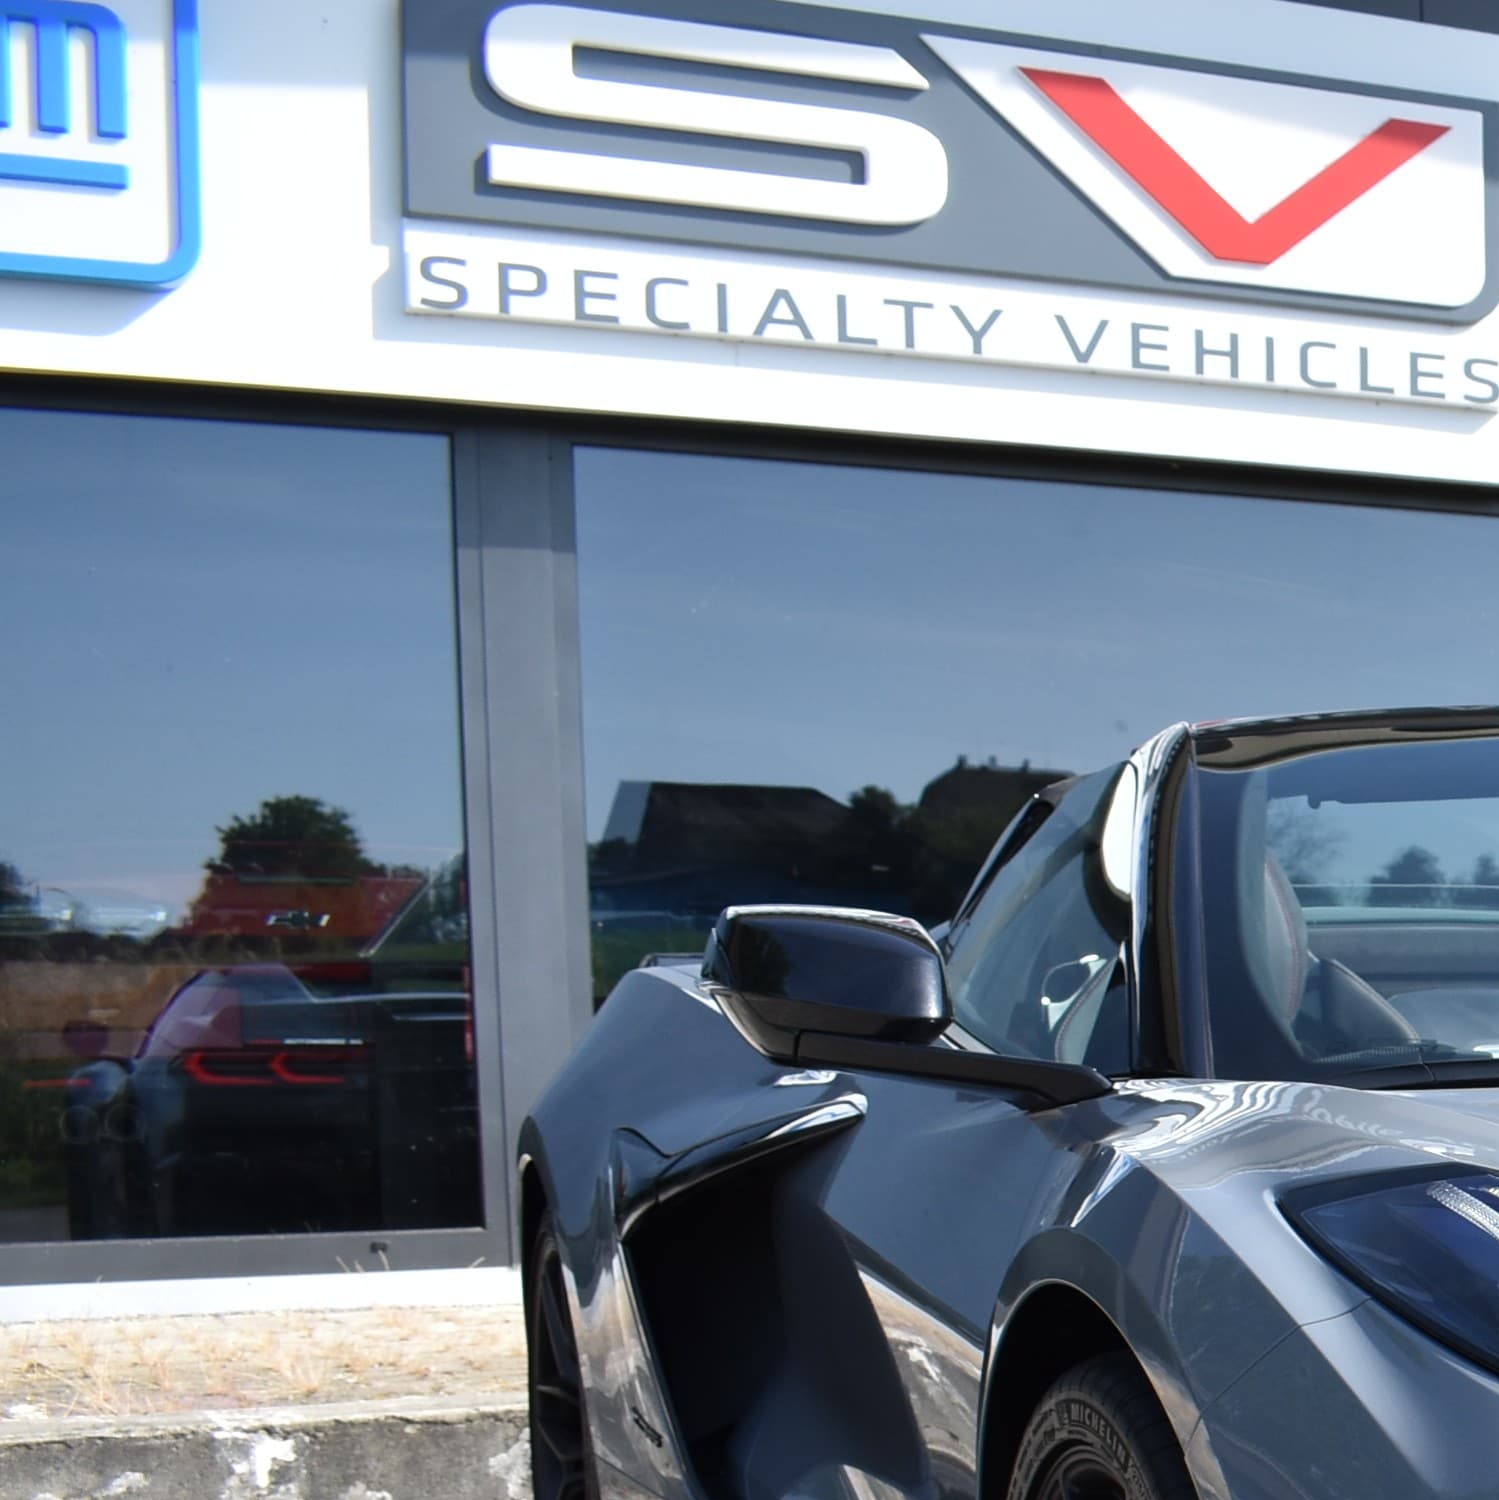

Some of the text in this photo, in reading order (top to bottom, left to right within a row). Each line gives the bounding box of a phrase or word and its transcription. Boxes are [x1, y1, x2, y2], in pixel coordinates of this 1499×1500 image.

[482, 2, 1456, 272] SV
[418, 254, 1003, 357] SPECIALTY
[1070, 1402, 1127, 1464] MICHELIN
